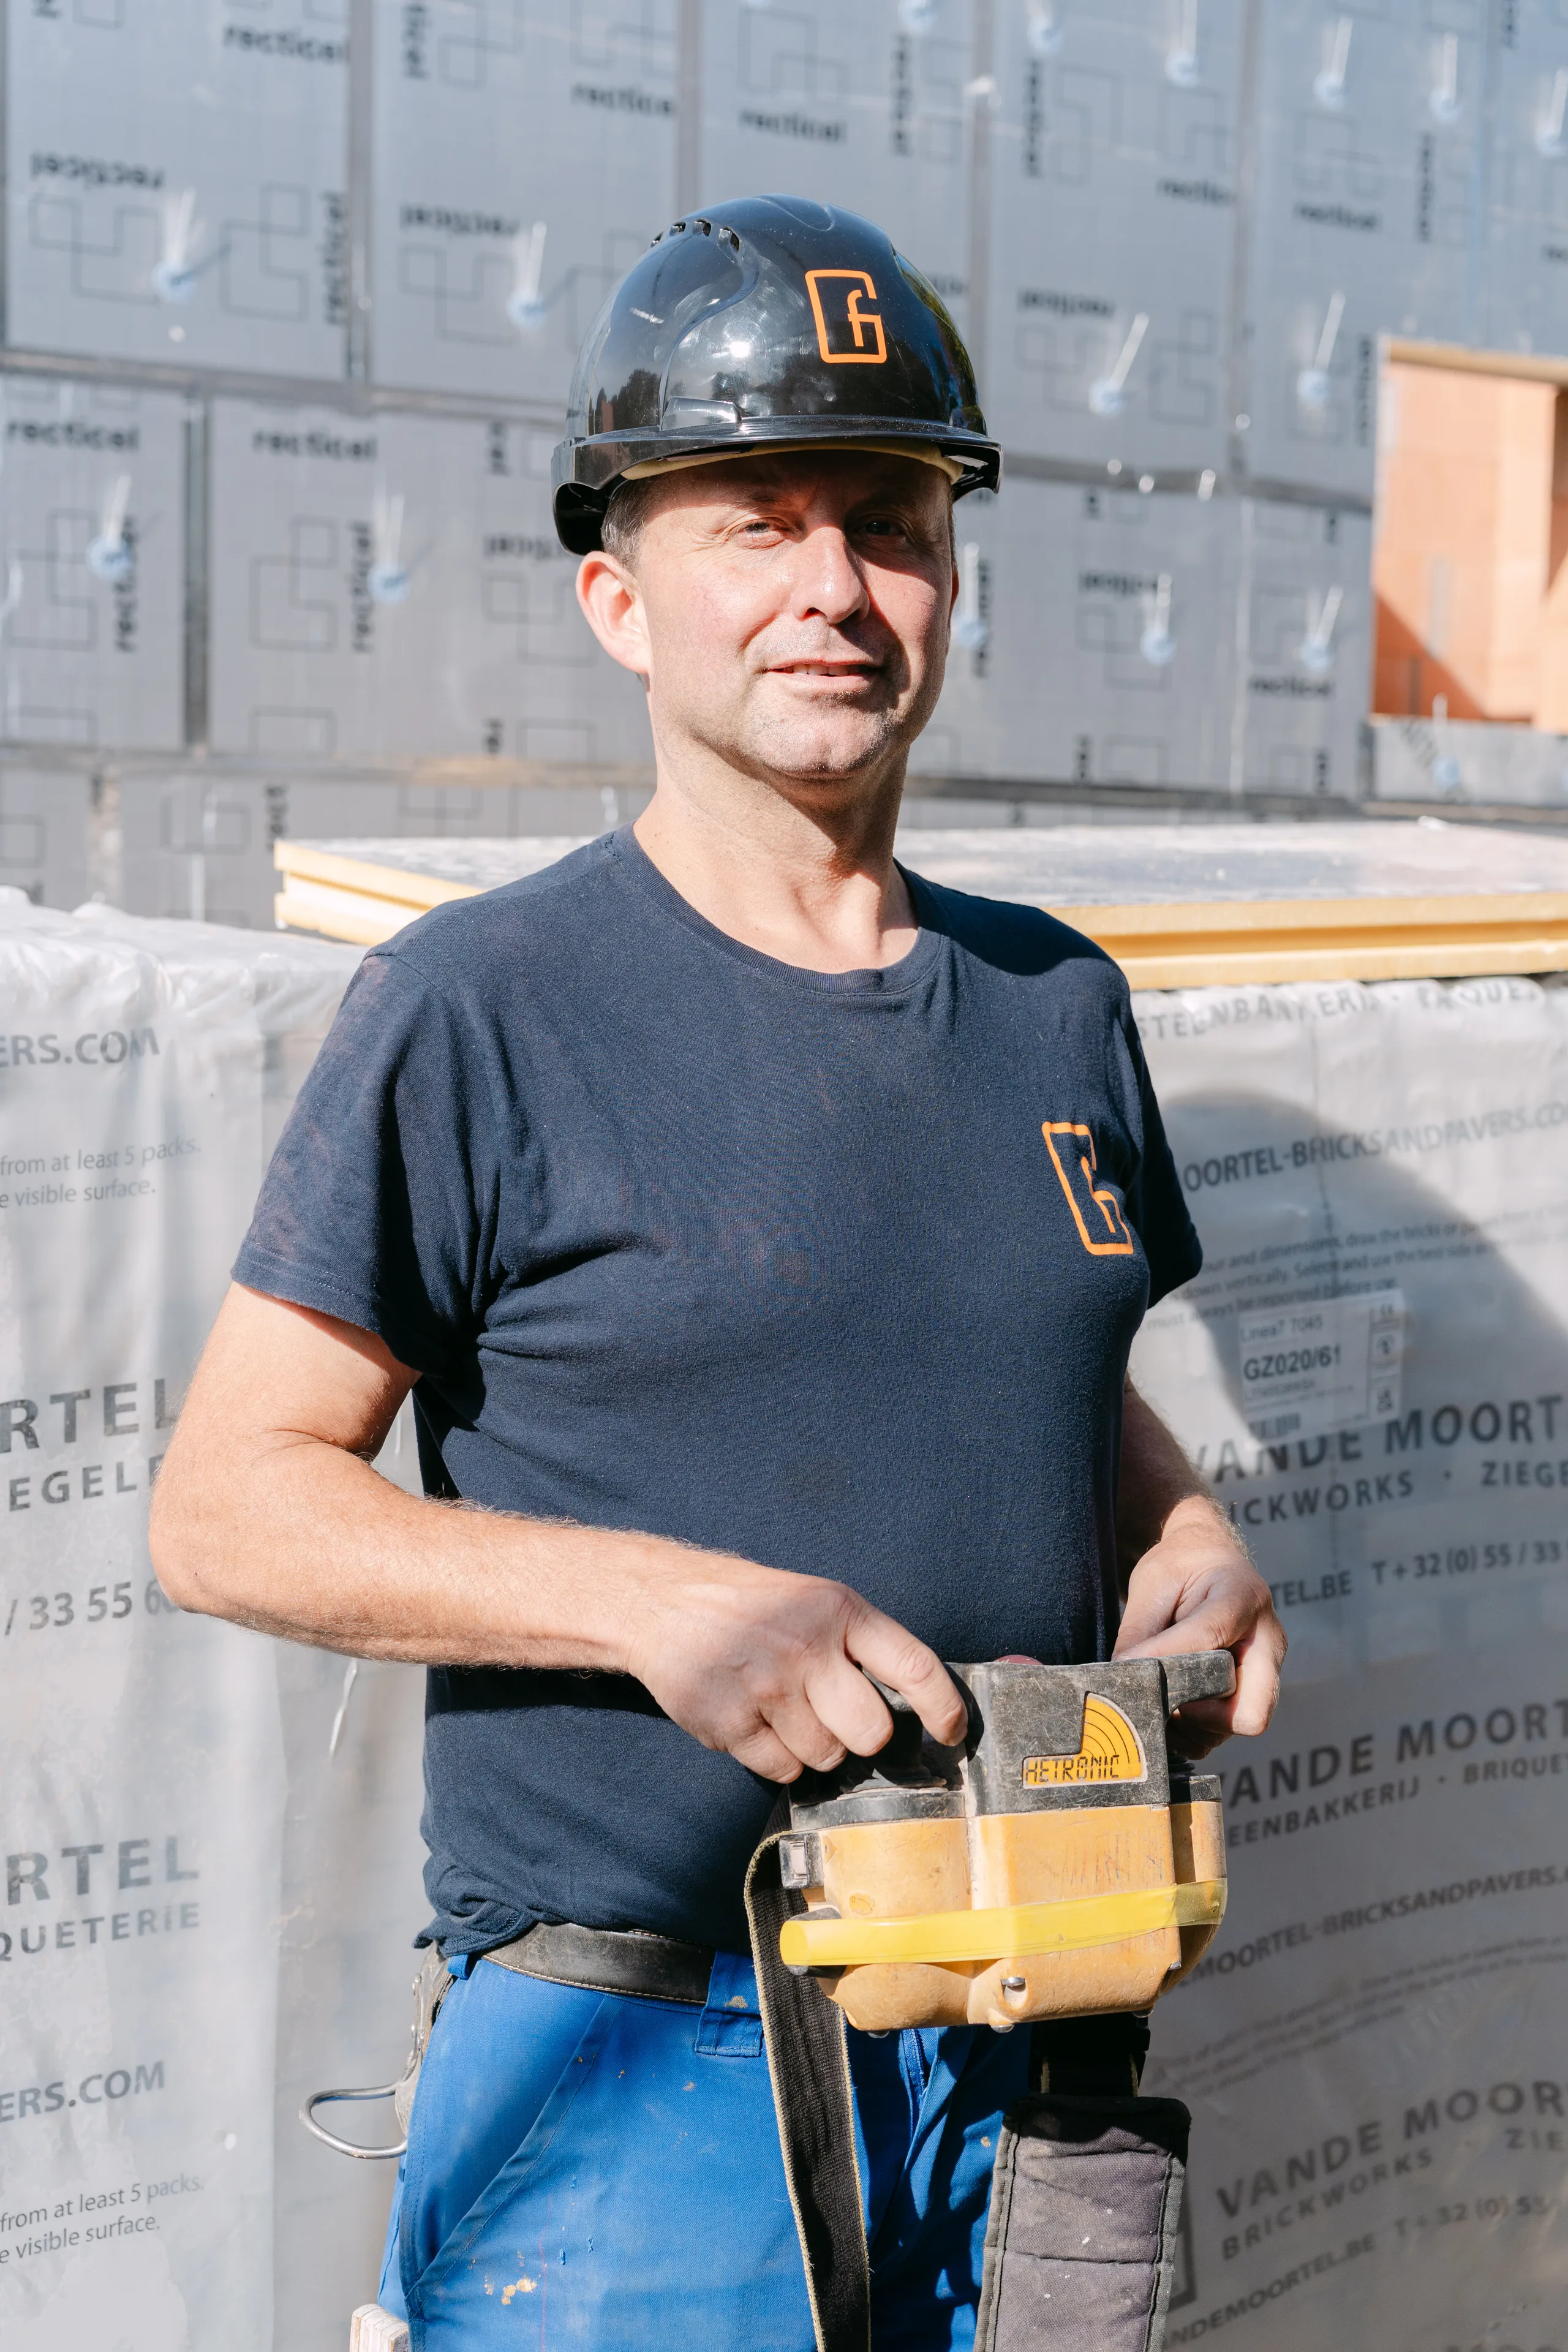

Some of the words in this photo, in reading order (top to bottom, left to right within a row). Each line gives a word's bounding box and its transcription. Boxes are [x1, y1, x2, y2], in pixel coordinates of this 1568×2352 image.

[0, 1154, 46, 1177] from
[51, 1153, 70, 1172] at
[77, 1147, 119, 1170] least
[126, 1145, 135, 1166] 5
[141, 1134, 202, 1167] packs.
[15, 1183, 77, 1207] visible
[83, 1177, 156, 1202] surface.
[1243, 1343, 1341, 1381] GZ020/61
[0, 1378, 176, 1453] RTEL
[1385, 1393, 1563, 1455] MOORT
[29, 1593, 75, 1630] 33
[88, 1582, 132, 1623] 55
[1025, 1754, 1120, 1785] HETRONIC
[1221, 1732, 1374, 1809] ANDE
[1463, 1752, 1568, 1785] BRIQUE
[7, 1836, 200, 1906] RTEL
[1216, 2120, 1382, 2220] VANDE
[0, 2207, 48, 2233] from
[54, 2199, 74, 2219] at
[80, 2188, 125, 2214] least
[130, 2183, 141, 2203] 5
[146, 2173, 205, 2204] packs.
[16, 2228, 80, 2260] visible
[86, 2214, 160, 2242] surface.
